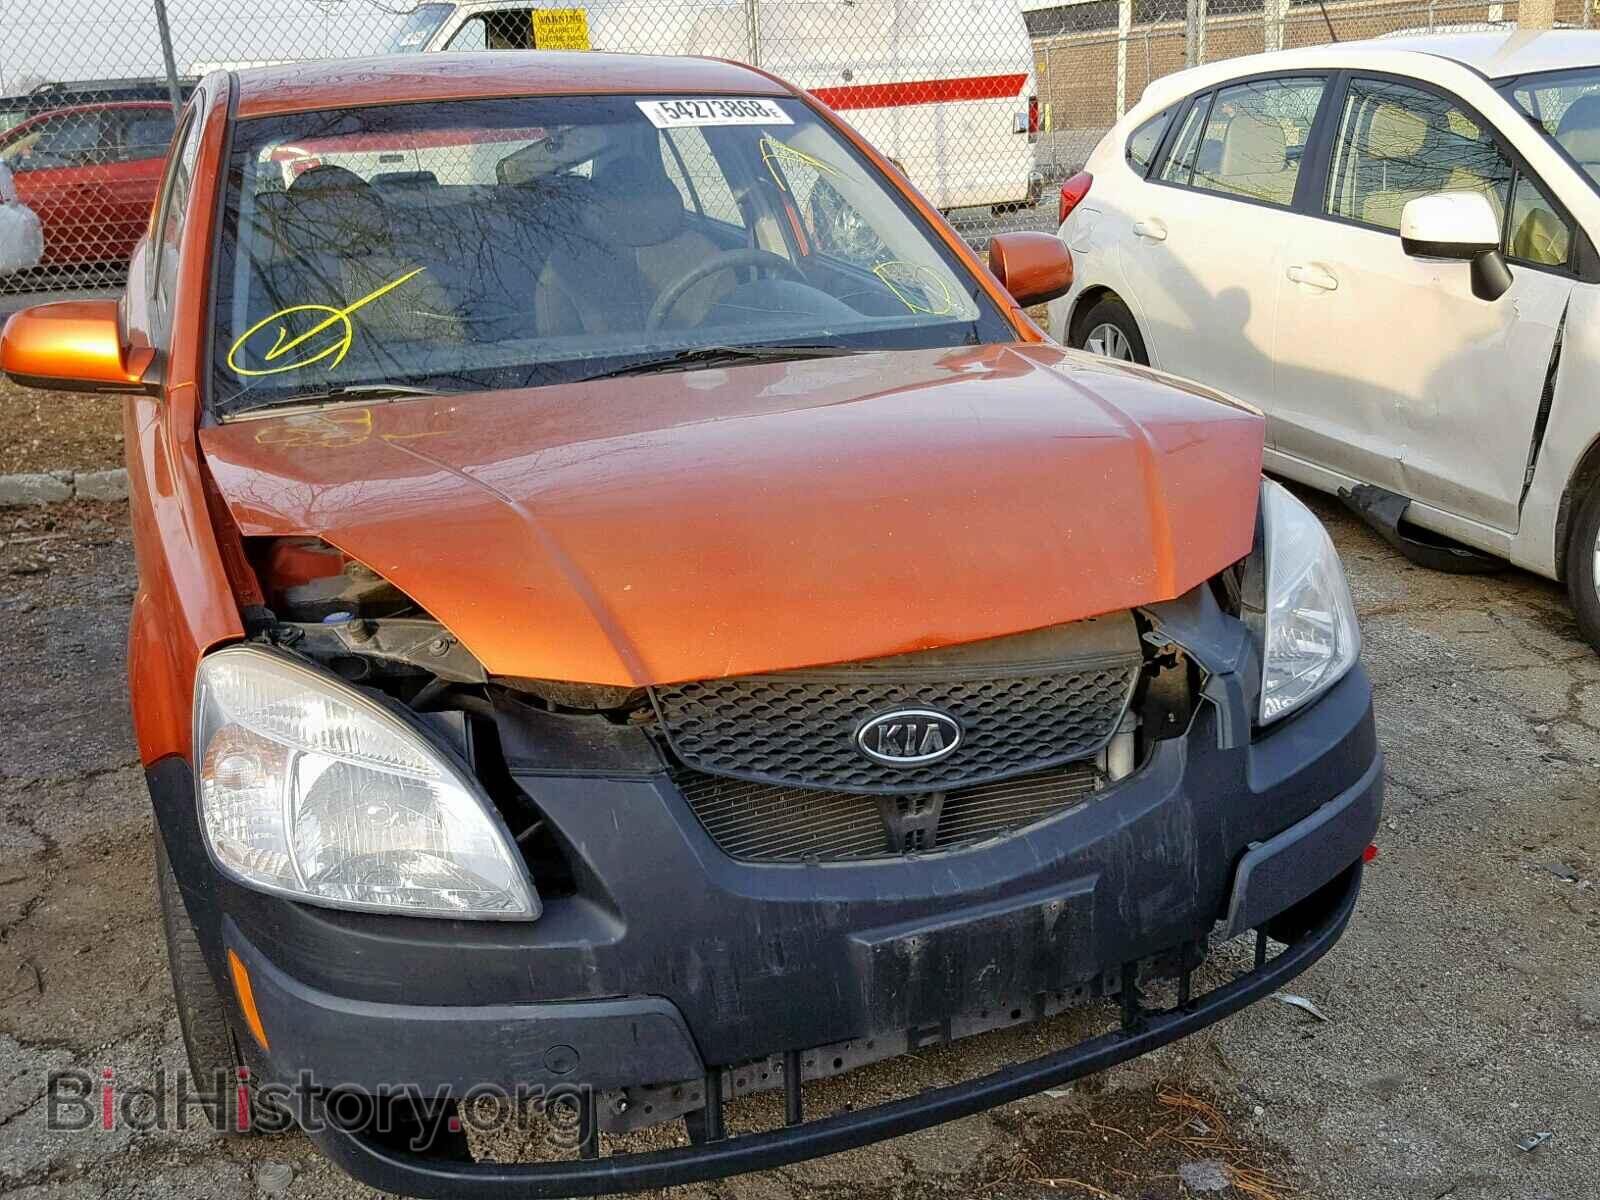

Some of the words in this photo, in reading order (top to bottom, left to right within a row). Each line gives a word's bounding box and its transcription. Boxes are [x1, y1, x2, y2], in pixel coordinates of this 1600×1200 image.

[538, 15, 583, 25] WARNING
[658, 101, 769, 120] 54273868
[877, 724, 944, 756] KIA
